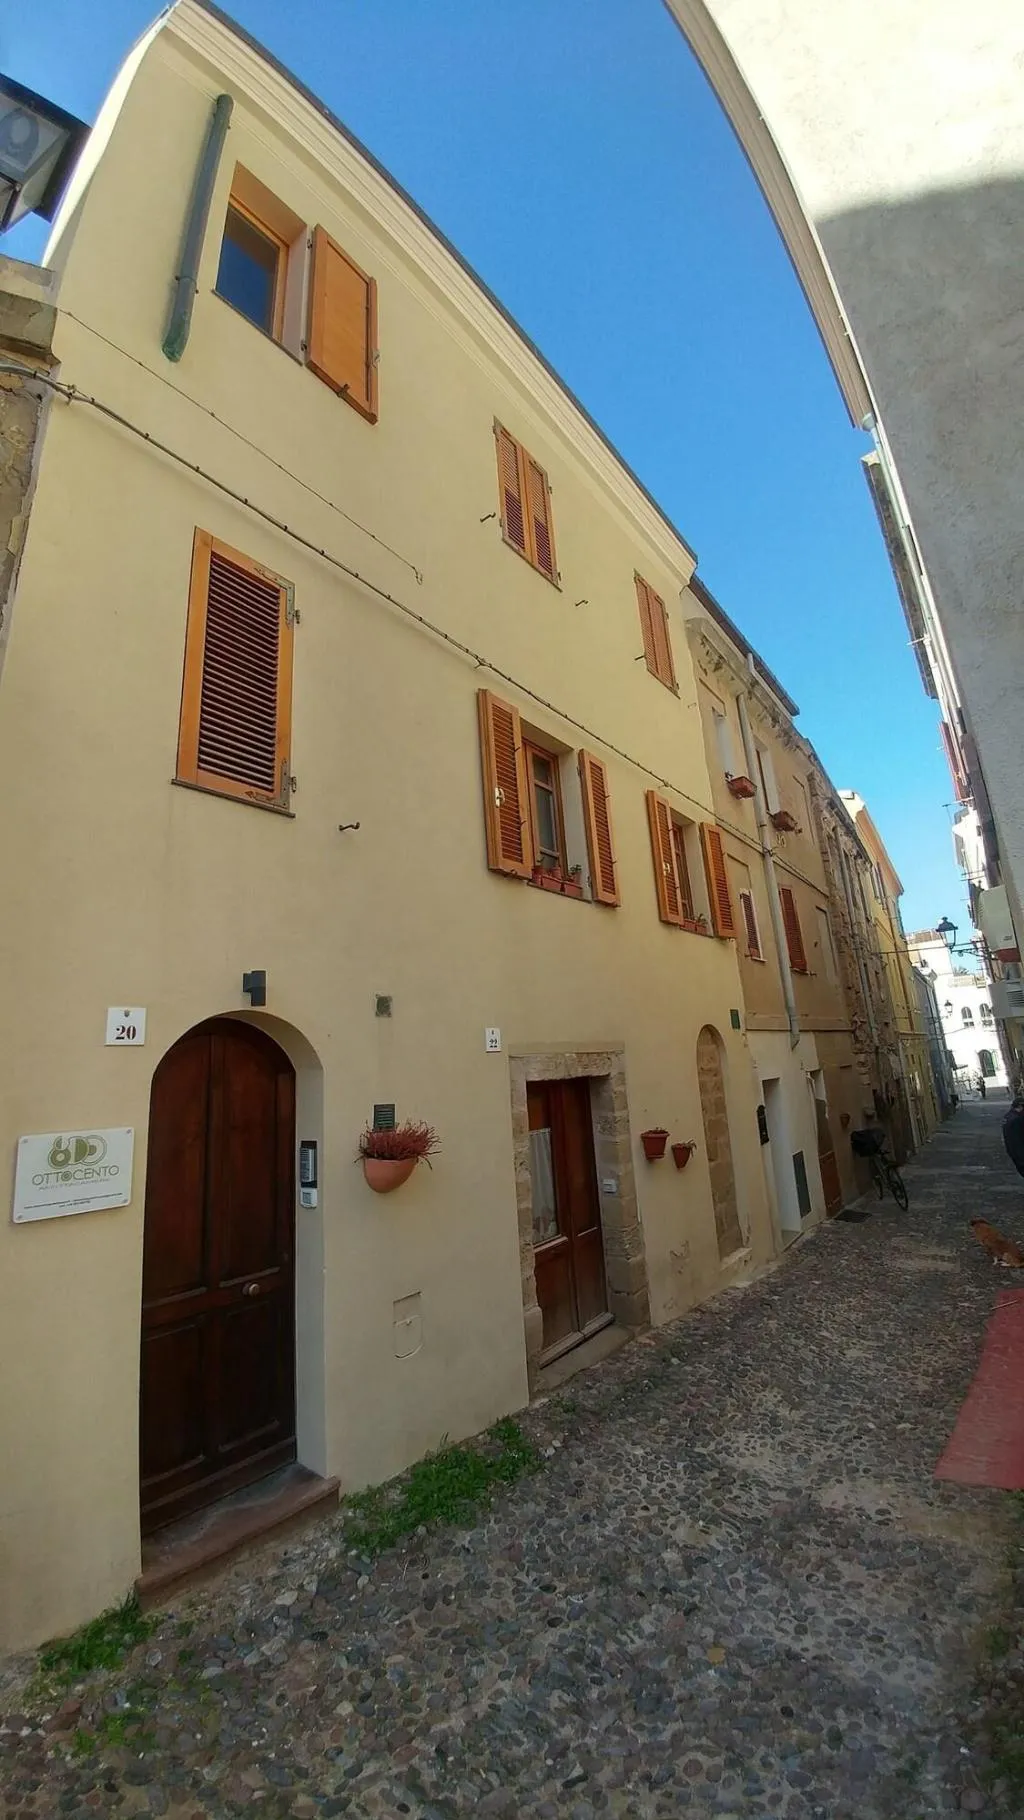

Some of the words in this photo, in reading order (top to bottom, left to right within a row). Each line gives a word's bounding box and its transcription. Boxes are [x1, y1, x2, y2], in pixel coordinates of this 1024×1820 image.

[115, 1025, 136, 1040] 20
[489, 1038, 498, 1048] 22
[32, 1165, 119, 1185] OTTOCENTO
